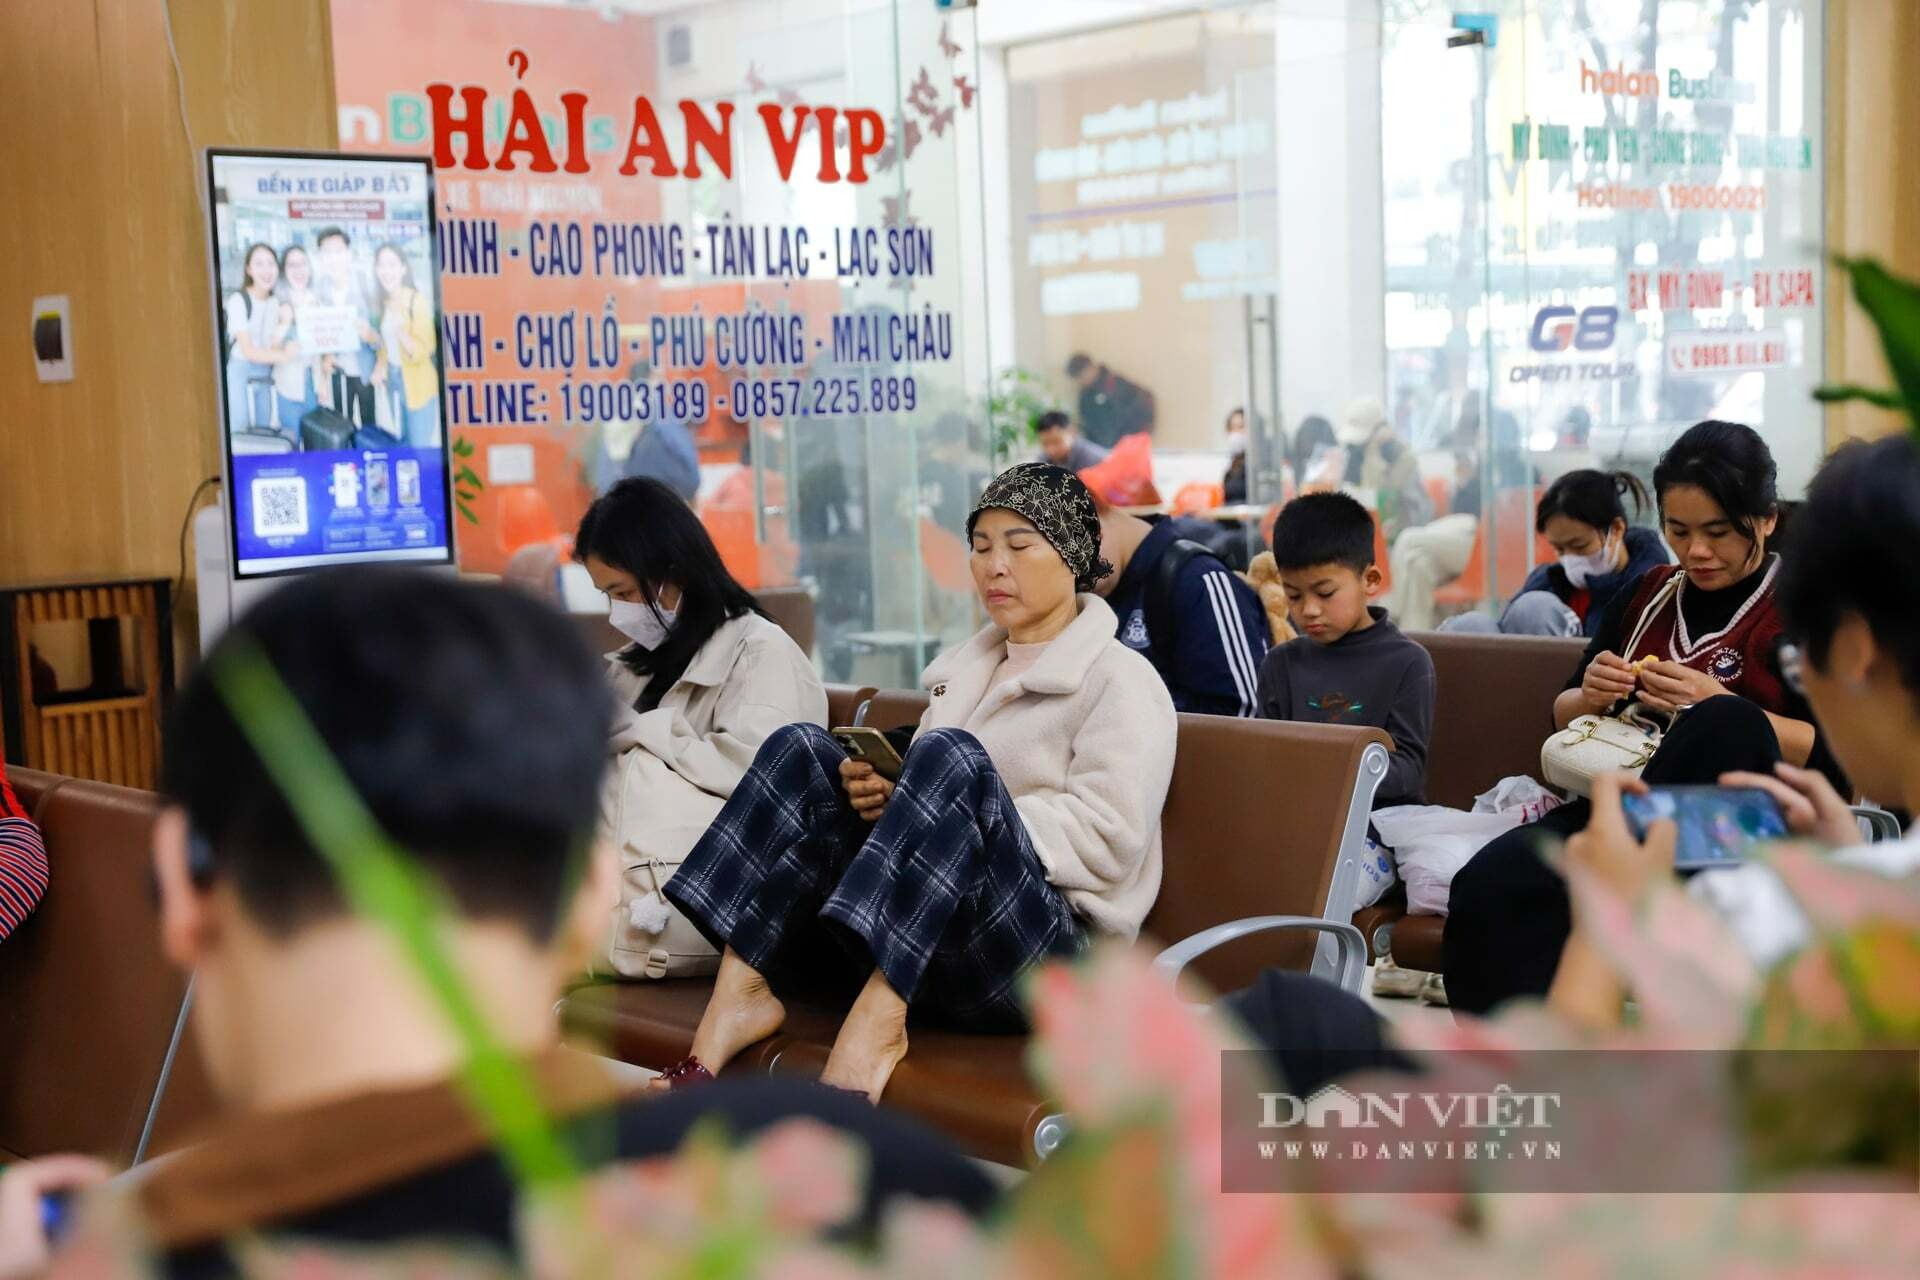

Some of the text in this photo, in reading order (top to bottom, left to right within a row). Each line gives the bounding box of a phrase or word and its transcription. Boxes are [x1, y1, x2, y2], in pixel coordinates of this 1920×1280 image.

[1579, 59, 1660, 97] halan
[426, 49, 591, 175] HẢI
[619, 96, 735, 180] AN
[758, 103, 886, 184] VIP
[257, 170, 292, 193] BẾN
[296, 177, 318, 193] XE
[322, 171, 366, 193] GIÁP
[529, 222, 583, 276] CAO
[593, 222, 685, 276] PHONG
[706, 211, 756, 276] TÂN
[765, 226, 809, 288] LẠC
[835, 226, 879, 288] LẠC
[888, 225, 934, 276] SƠN
[517, 311, 575, 377] CHỢ
[716, 300, 804, 367] CƯỜNG
[833, 315, 881, 363] MAI
[889, 301, 952, 362] CHÂU
[1528, 304, 1618, 352] G8
[448, 384, 548, 423] TLINE:
[560, 382, 706, 422] 19003189
[733, 376, 916, 418] 0857.225.889
